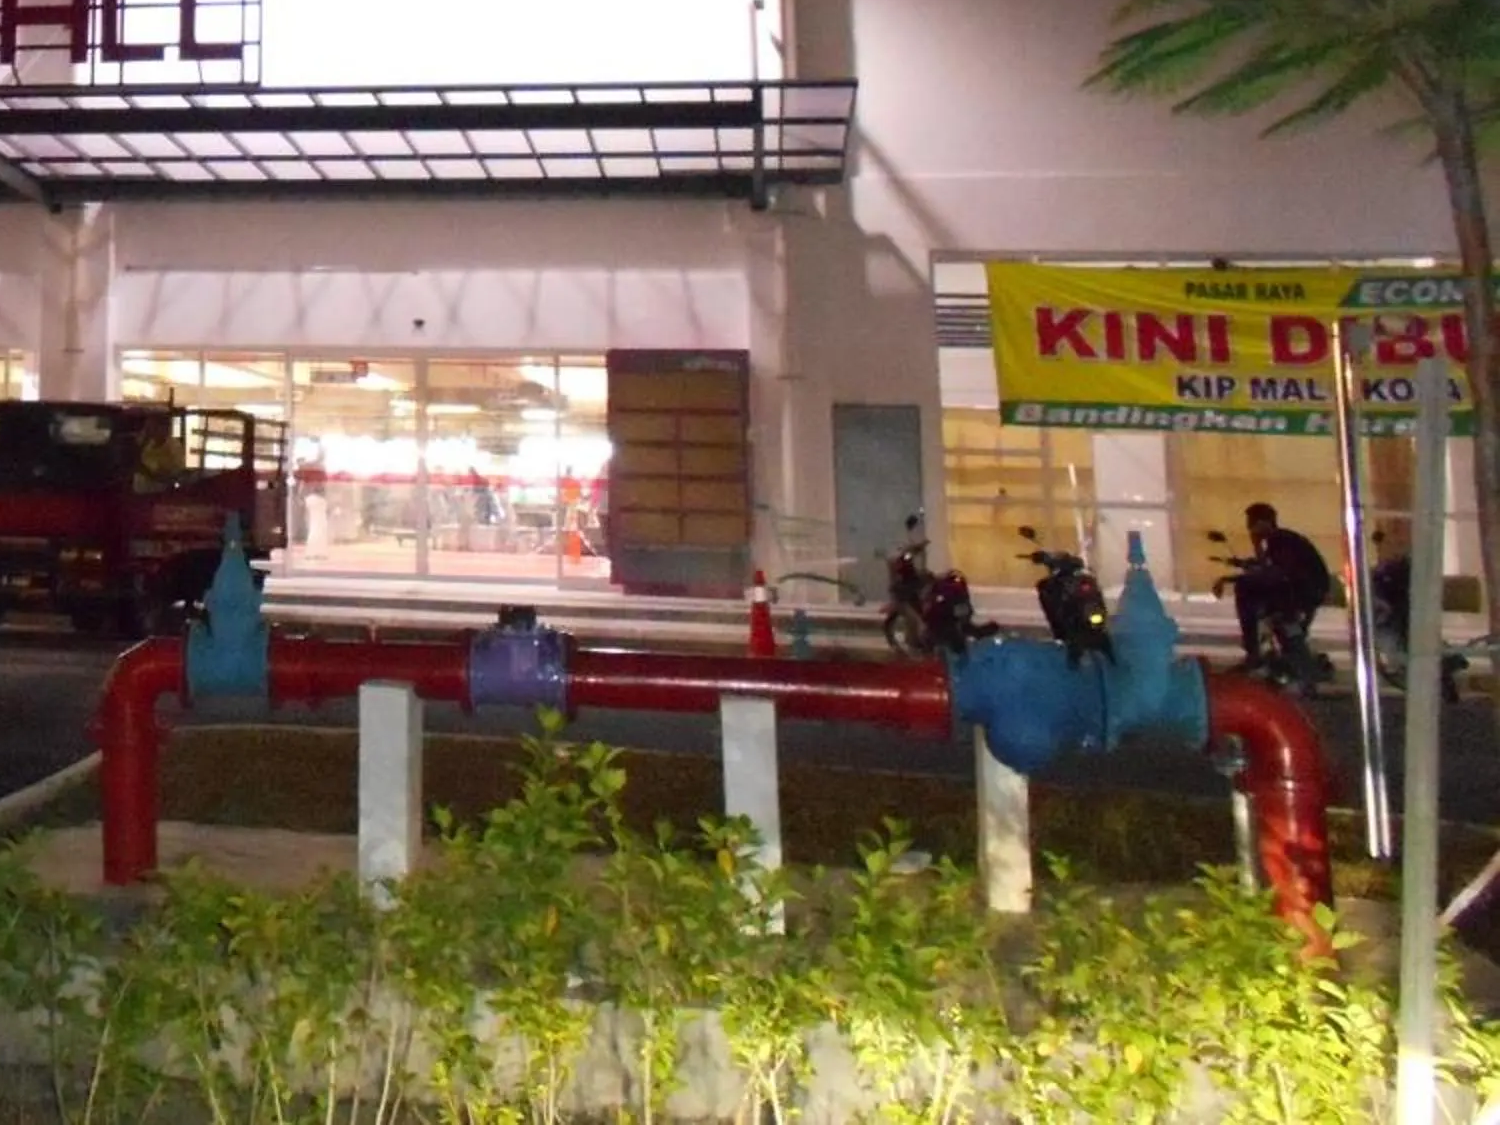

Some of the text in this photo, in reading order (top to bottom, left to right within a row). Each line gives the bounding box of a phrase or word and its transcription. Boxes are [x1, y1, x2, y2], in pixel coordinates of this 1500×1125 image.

[1035, 306, 1231, 363] KINI
[1176, 376, 1236, 399] KIP
[1250, 378, 1332, 401] MAL
